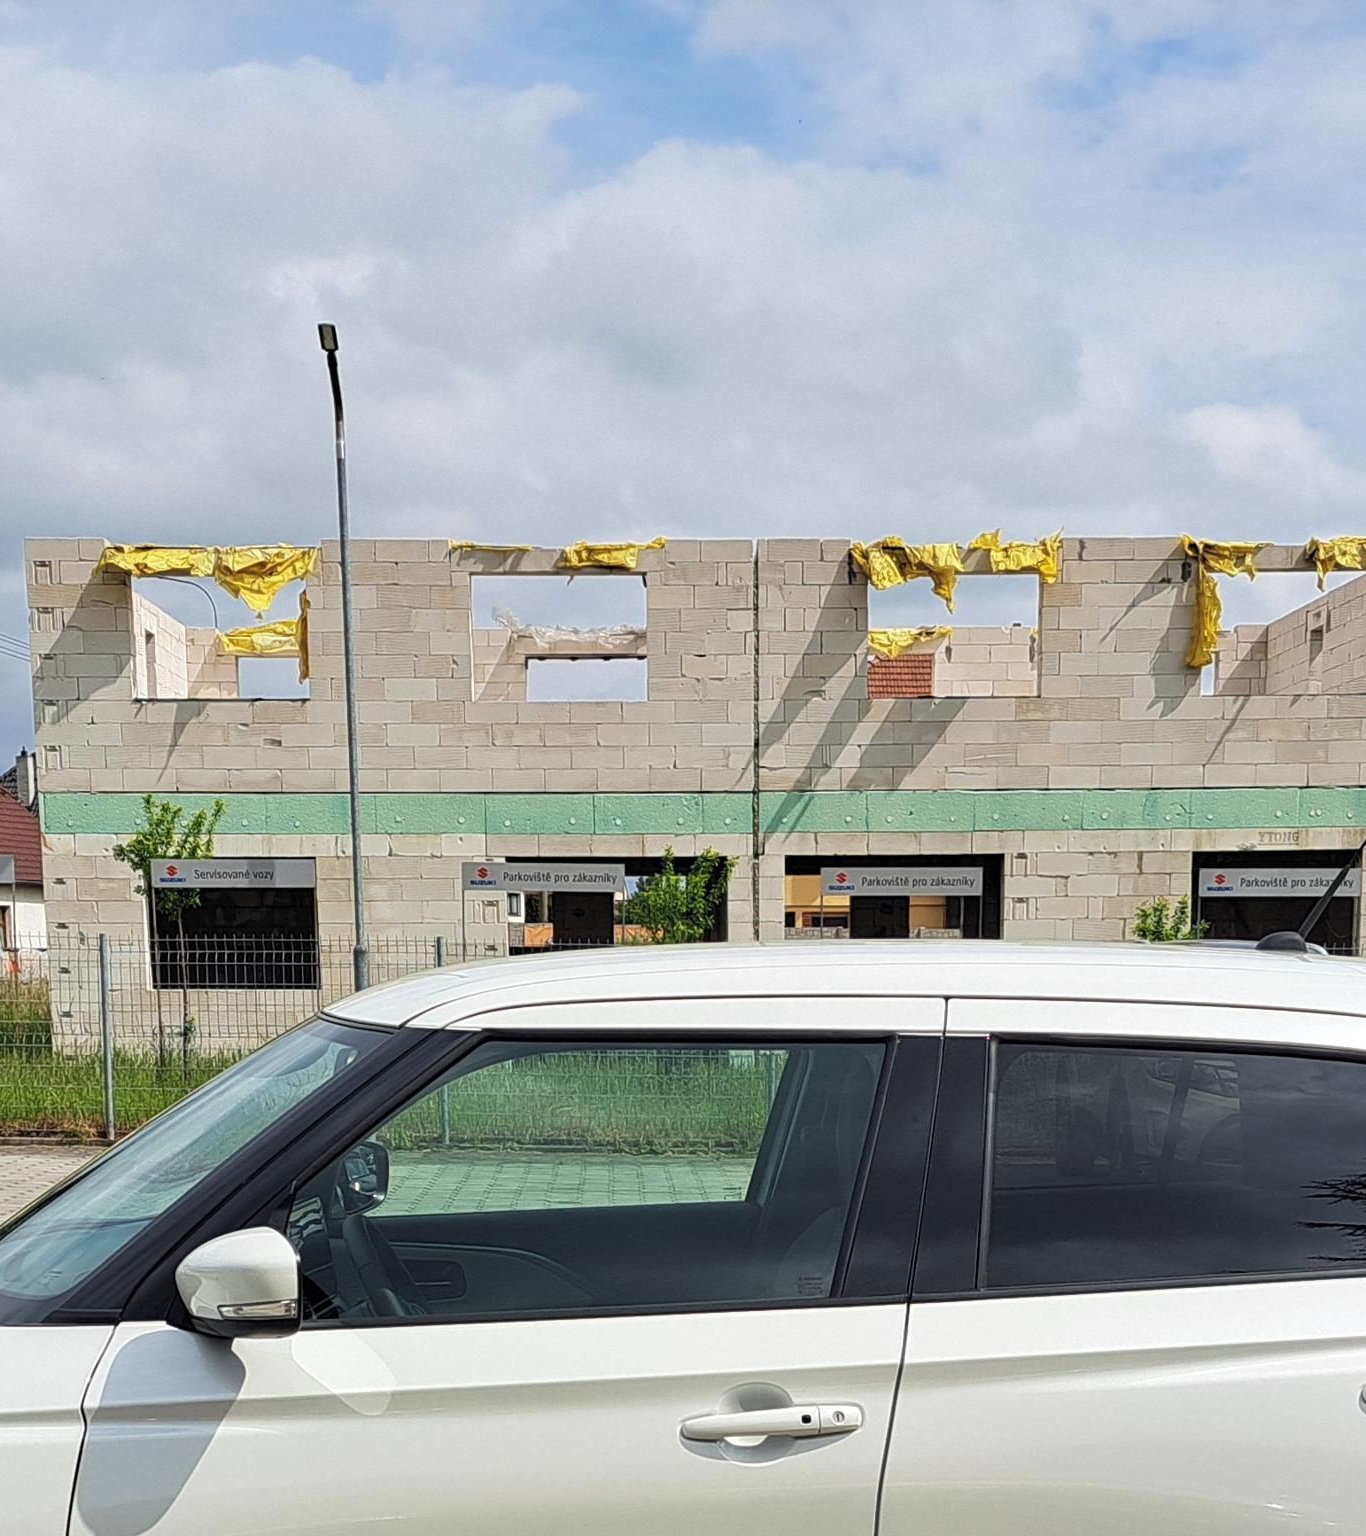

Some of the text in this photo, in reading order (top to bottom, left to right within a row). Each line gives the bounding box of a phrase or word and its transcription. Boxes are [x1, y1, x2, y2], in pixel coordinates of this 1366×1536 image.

[1258, 832, 1299, 842] YTONG
[194, 868, 275, 881] Servisované vozy
[503, 871, 618, 884] Parkoviště pro zákazníky
[861, 876, 975, 889] Parkoviště pro zákazníky
[1240, 877, 1288, 888] Parkoviště
[1290, 879, 1306, 889] pro
